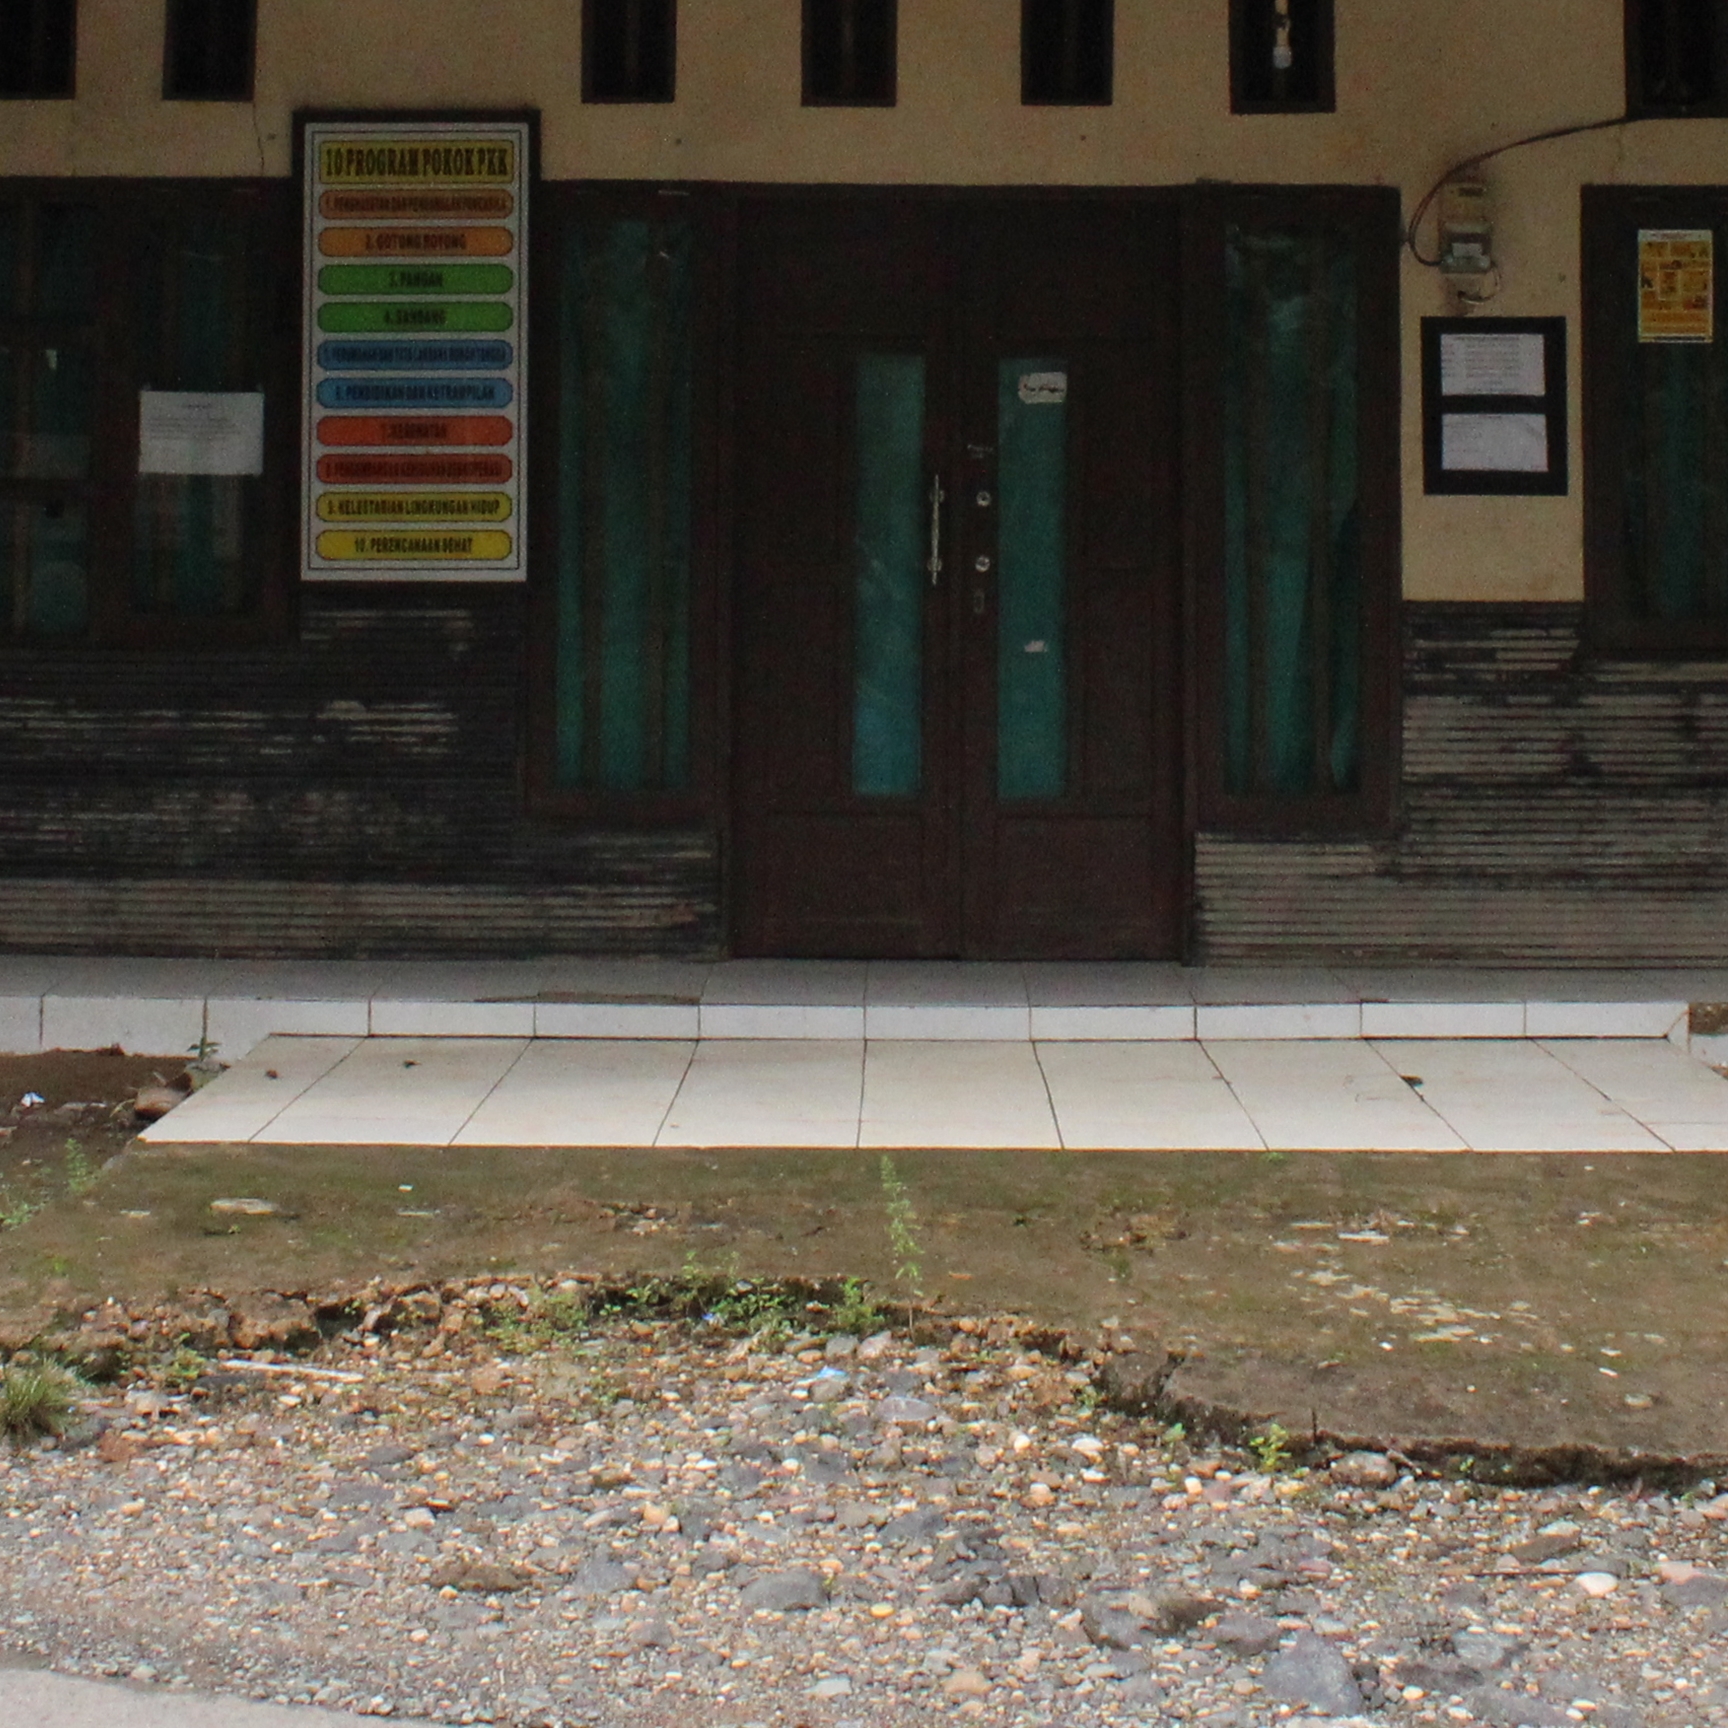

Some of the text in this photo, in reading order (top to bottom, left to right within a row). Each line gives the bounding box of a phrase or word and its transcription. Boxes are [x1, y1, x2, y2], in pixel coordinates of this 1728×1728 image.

[327, 149, 507, 175] 10 PROGRAM POKOK PKK
